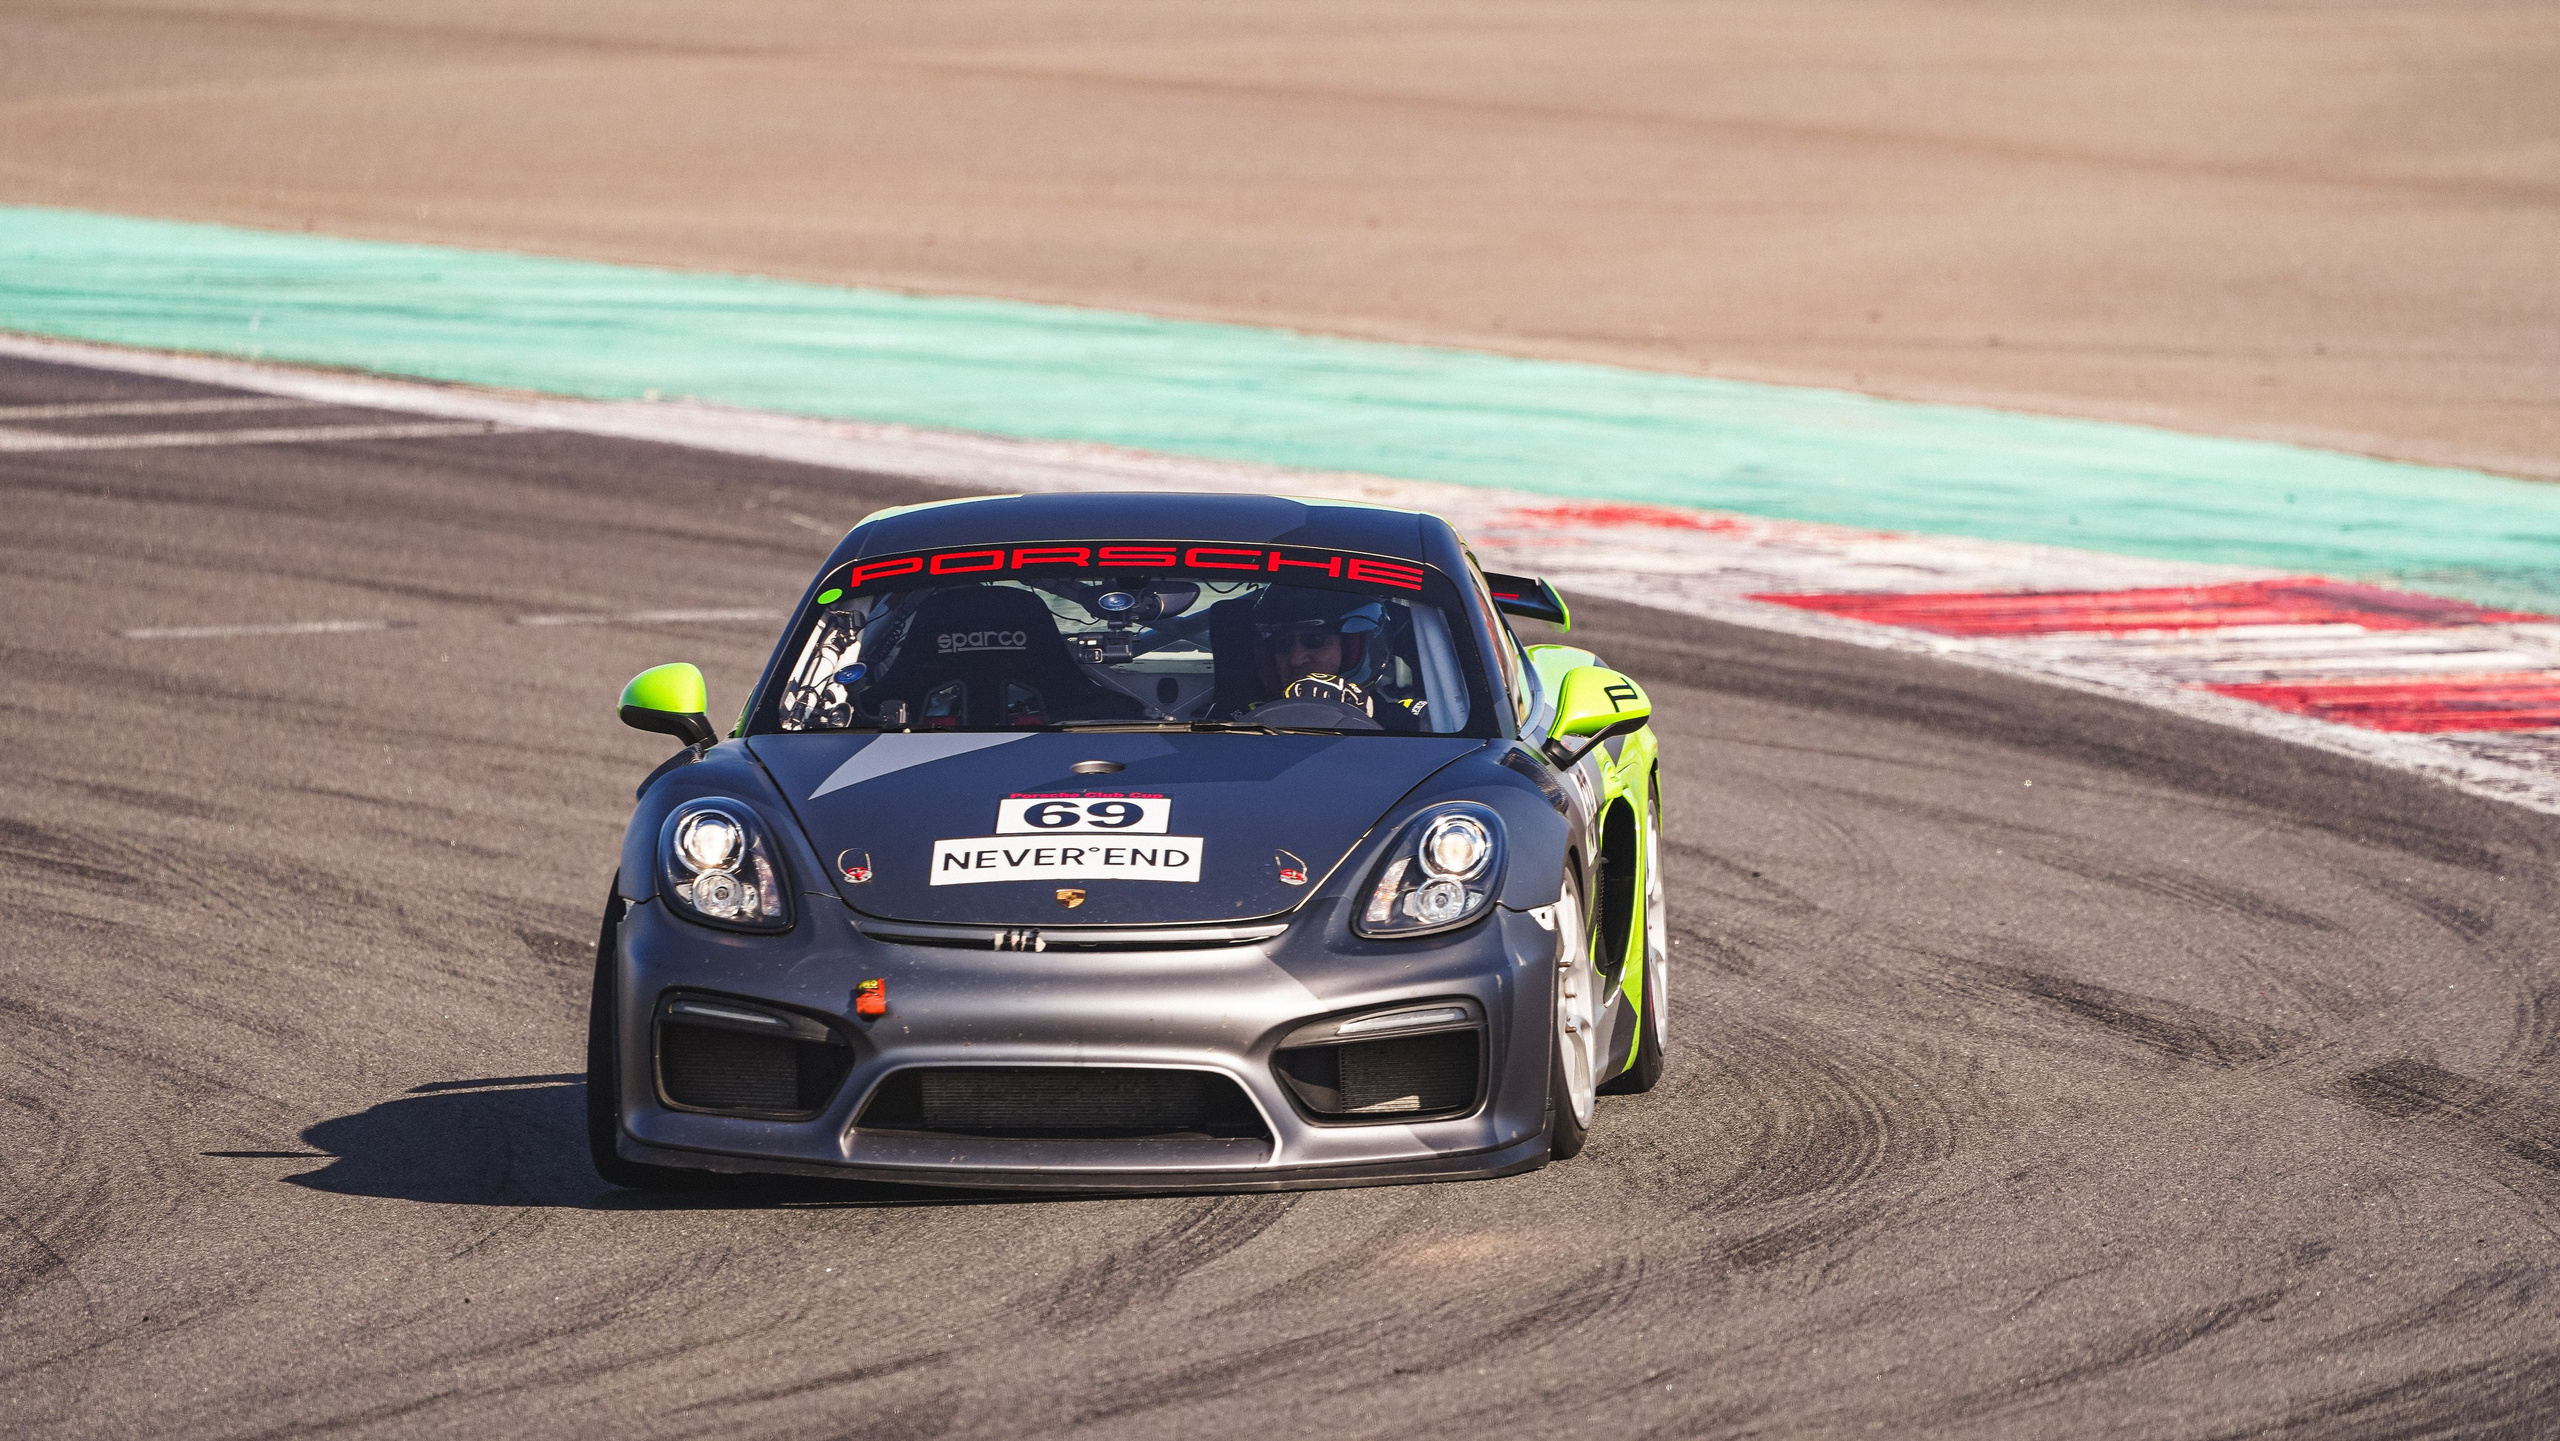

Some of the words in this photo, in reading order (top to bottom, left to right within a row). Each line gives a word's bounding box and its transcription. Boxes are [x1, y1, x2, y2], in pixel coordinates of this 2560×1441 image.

[850, 546, 1424, 591] PORSCHE
[937, 630, 1027, 653] sparco
[1009, 792, 1080, 800] Porsche
[1084, 791, 1125, 799] Club
[1128, 791, 1164, 800] Cup
[1023, 801, 1144, 829] 69
